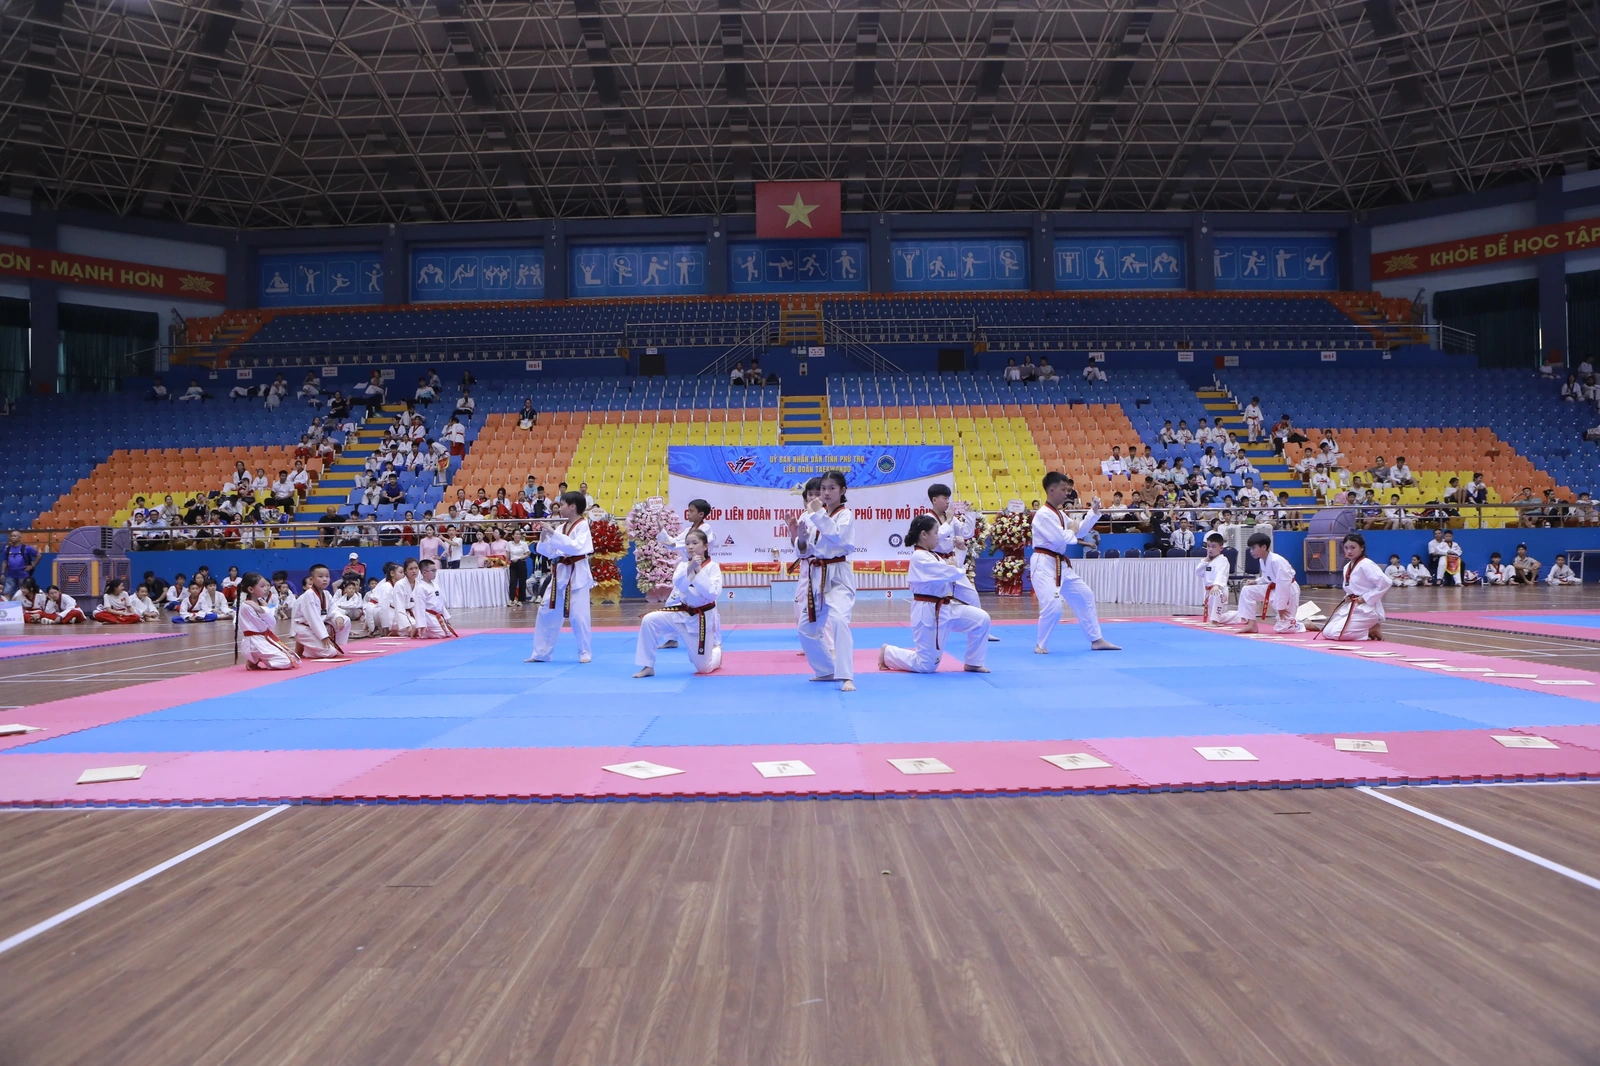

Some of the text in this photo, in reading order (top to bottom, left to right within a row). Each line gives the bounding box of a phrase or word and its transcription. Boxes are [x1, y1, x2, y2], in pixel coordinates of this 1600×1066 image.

[1430, 225, 1600, 266] KHỎE ĐỂ HỌC TẬP
[51, 260, 113, 282] MẠNH
[120, 270, 164, 288] HƠN
[793, 454, 809, 463] NHÂN
[810, 454, 822, 463] DÂN
[840, 454, 852, 463] PHÚ
[853, 455, 865, 463] THỌ
[783, 464, 796, 473] LIÊN
[797, 464, 814, 473] ĐOÀN
[725, 506, 744, 520] LIÊN
[747, 507, 771, 520] ĐOÀN
[854, 506, 872, 520] PHÚ
[875, 508, 892, 522] THỌ
[895, 504, 911, 520] MỞ
